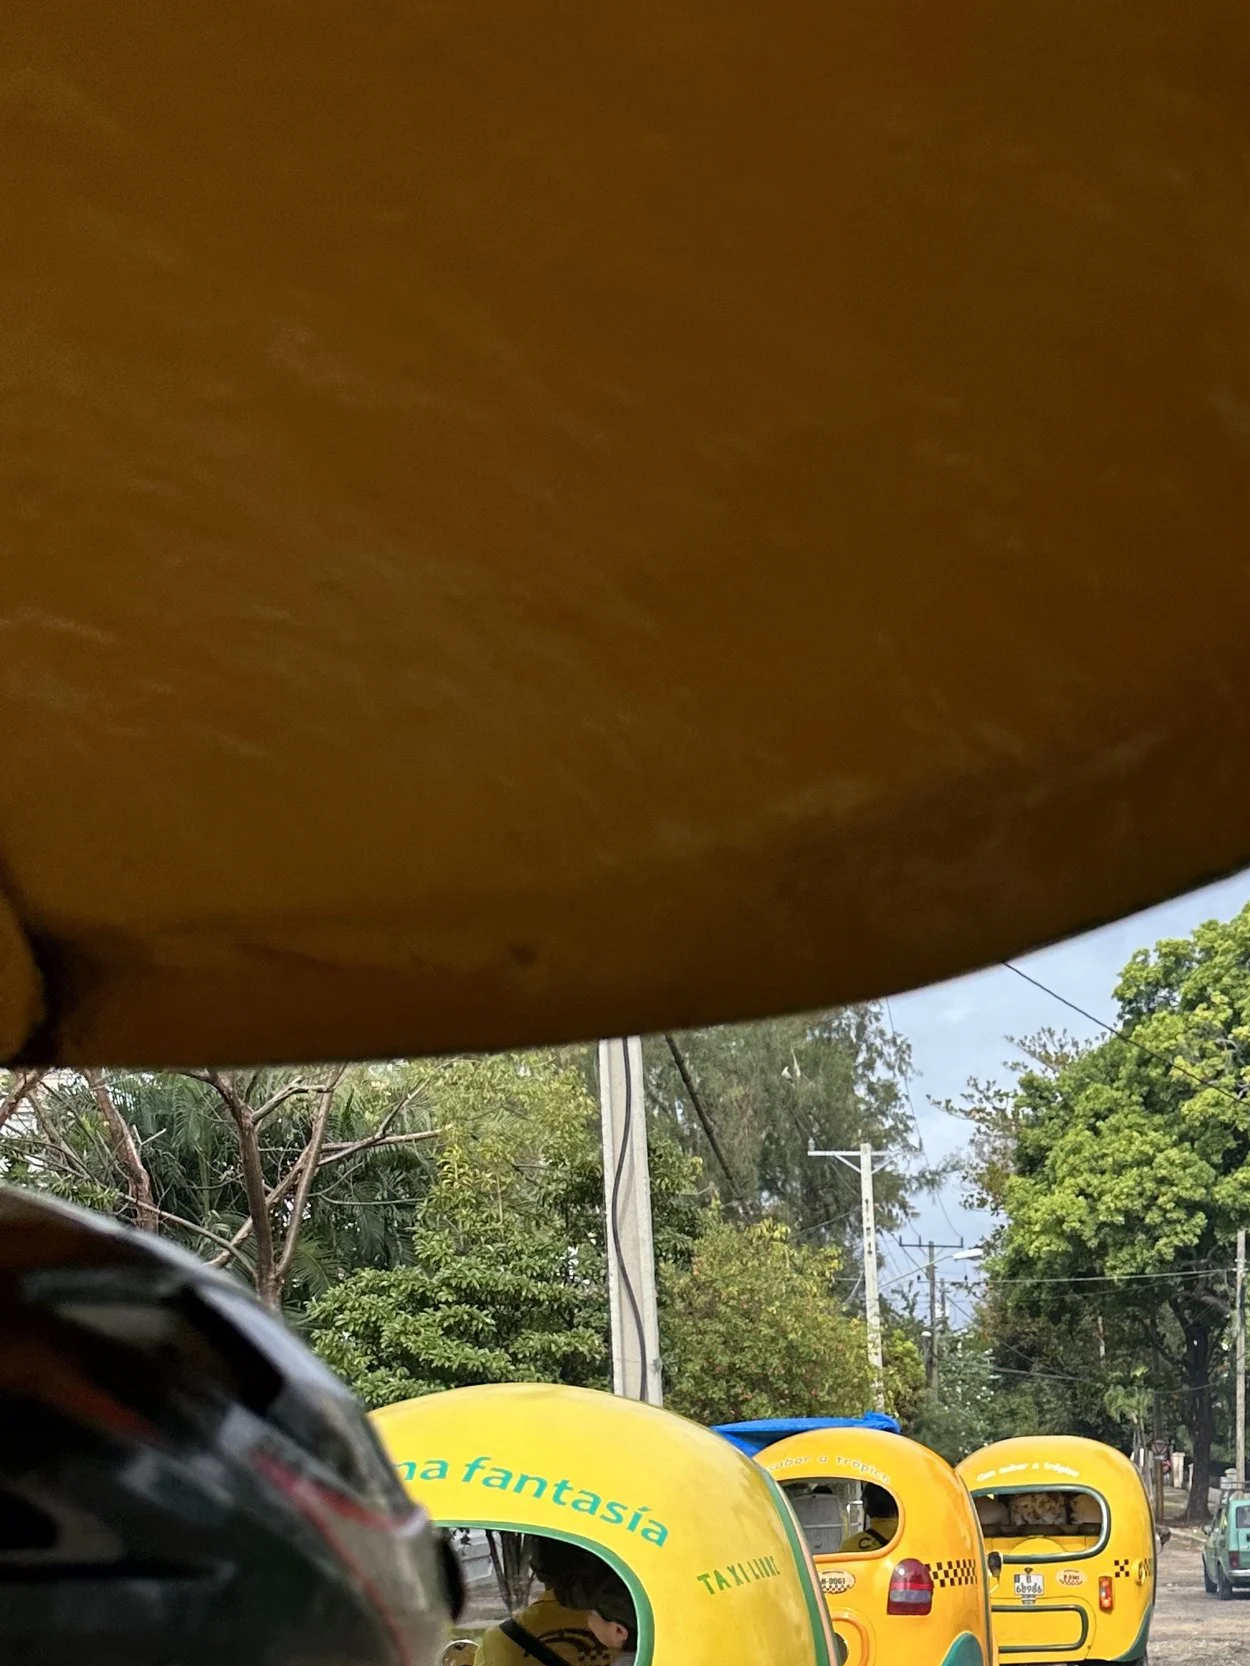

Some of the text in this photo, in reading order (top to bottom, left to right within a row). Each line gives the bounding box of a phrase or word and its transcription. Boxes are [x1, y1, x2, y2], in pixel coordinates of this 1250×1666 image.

[818, 1455, 829, 1464] a
[461, 1456, 669, 1548] fantasía
[696, 1562, 751, 1595] TAXI
